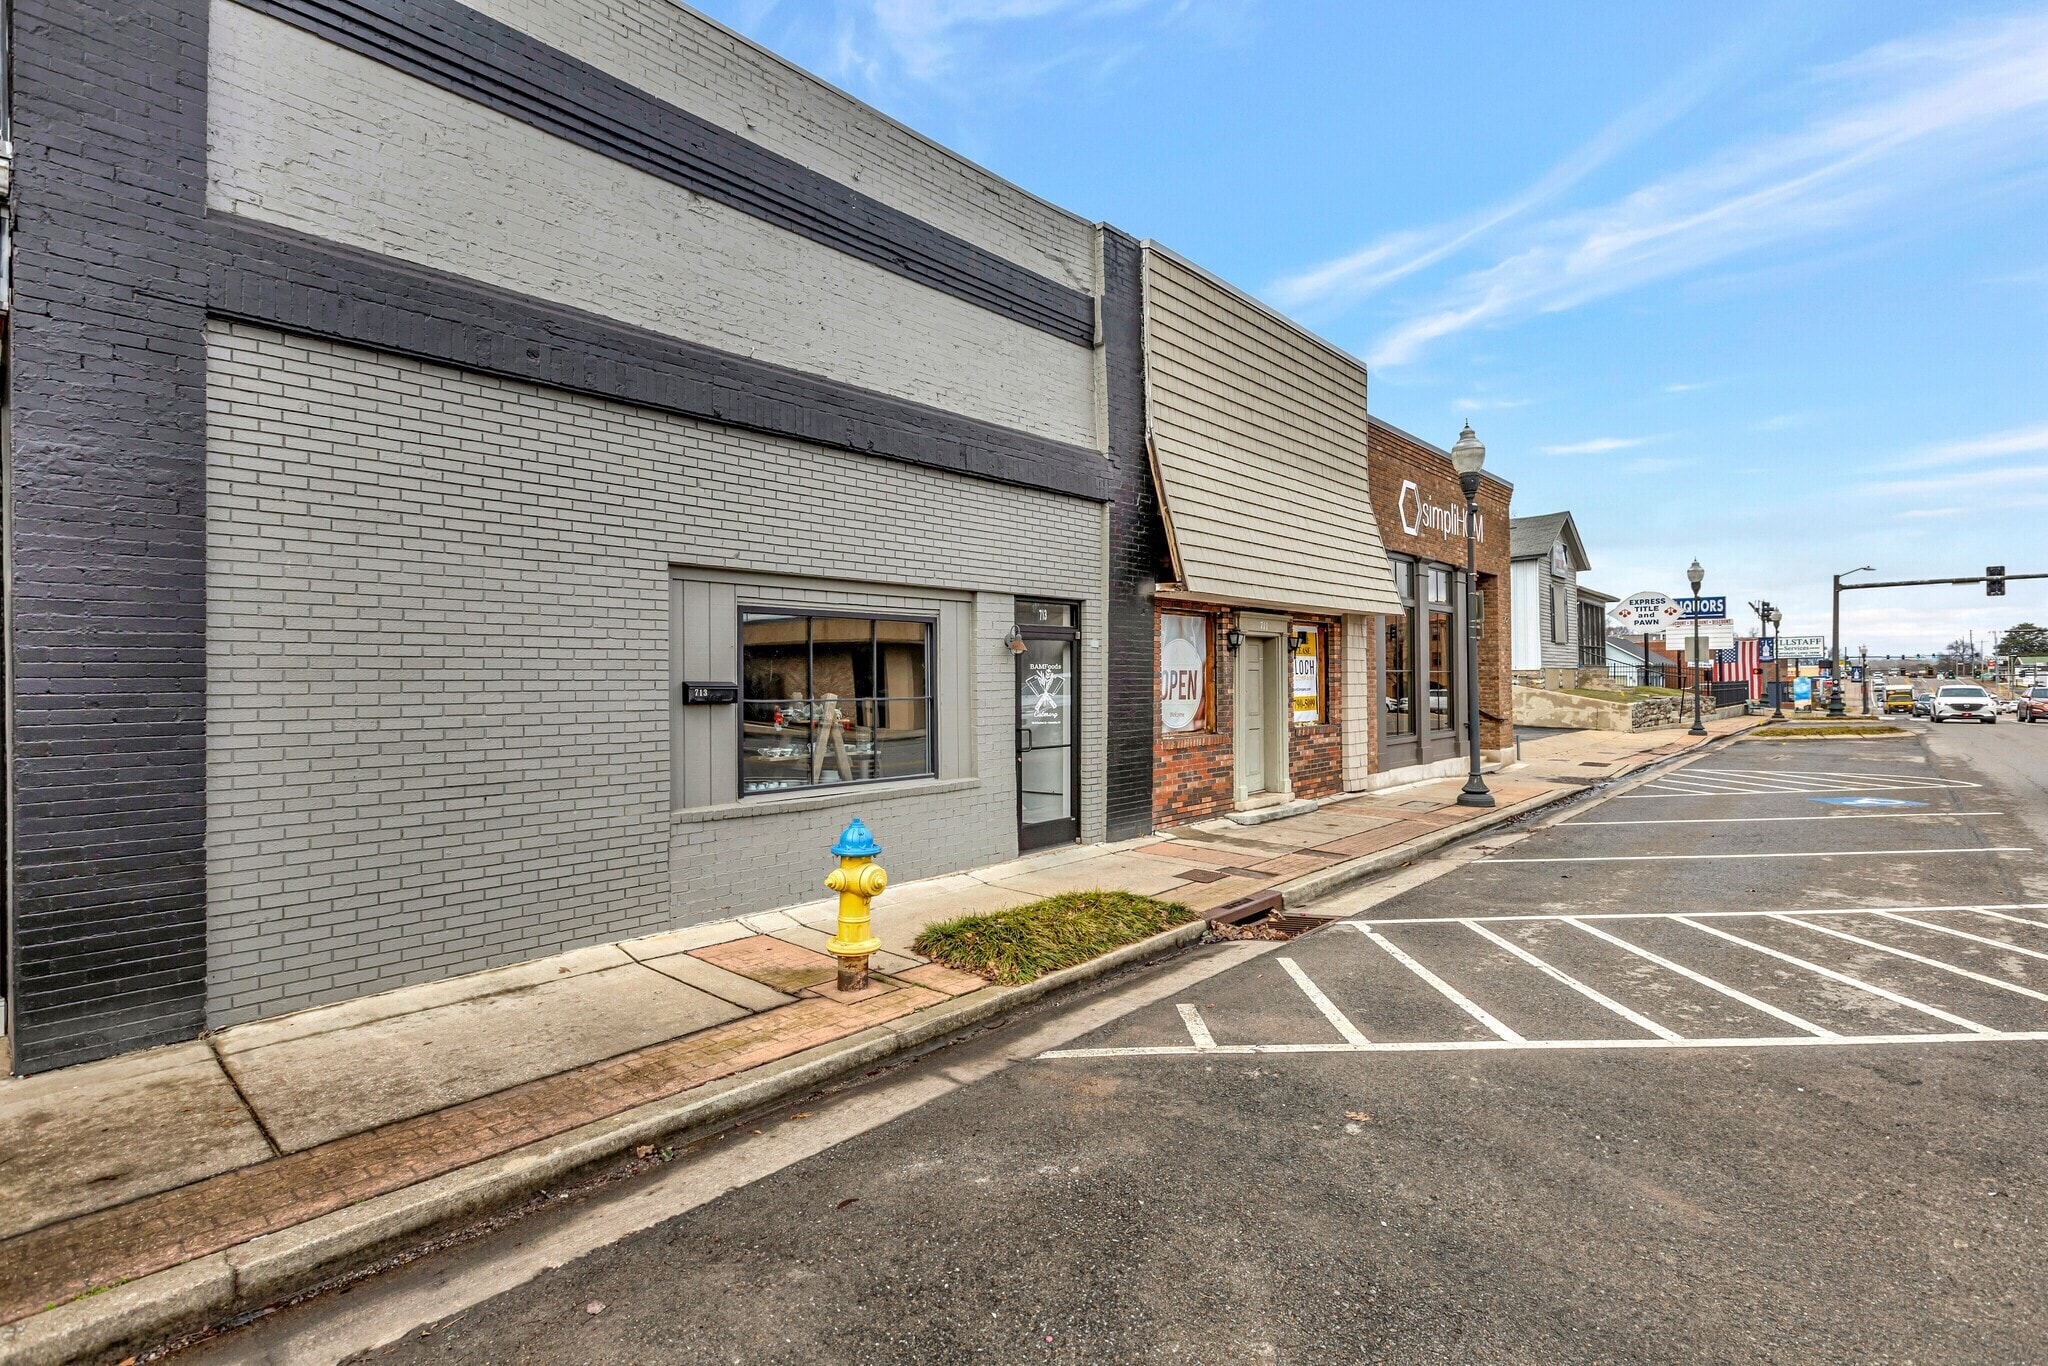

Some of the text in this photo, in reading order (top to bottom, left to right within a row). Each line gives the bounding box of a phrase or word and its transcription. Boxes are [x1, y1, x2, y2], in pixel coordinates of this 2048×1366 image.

[1680, 599, 1724, 613] IQUORS
[1039, 609, 1048, 621] 713
[1779, 638, 1822, 646] LLSTAFF
[1161, 670, 1197, 700] OPEN
[694, 689, 708, 697] 713
